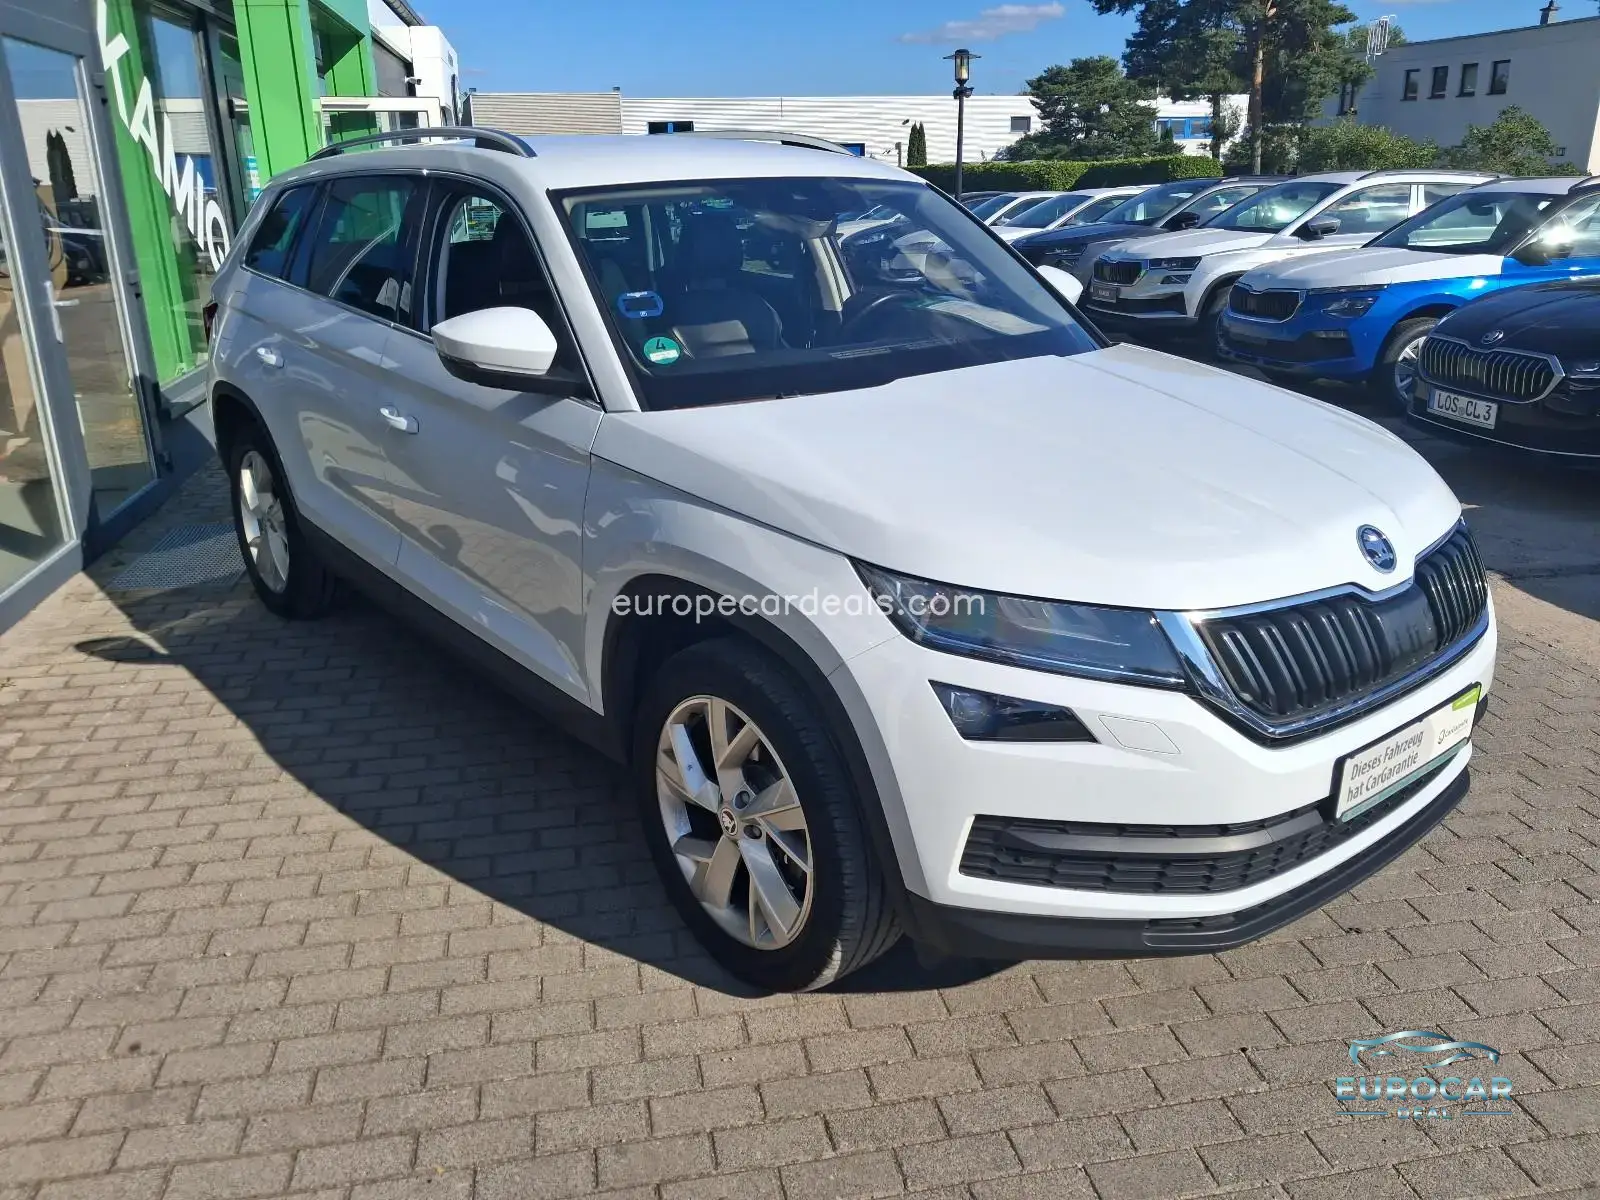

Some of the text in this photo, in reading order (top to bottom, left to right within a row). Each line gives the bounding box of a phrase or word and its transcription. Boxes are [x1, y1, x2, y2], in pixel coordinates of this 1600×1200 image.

[655, 338, 667, 351] 4
[1437, 392, 1492, 422] LOS CL 3
[1350, 731, 1425, 781] Dieses Fahrzeug
[1346, 751, 1419, 803] hat CarGarantie
